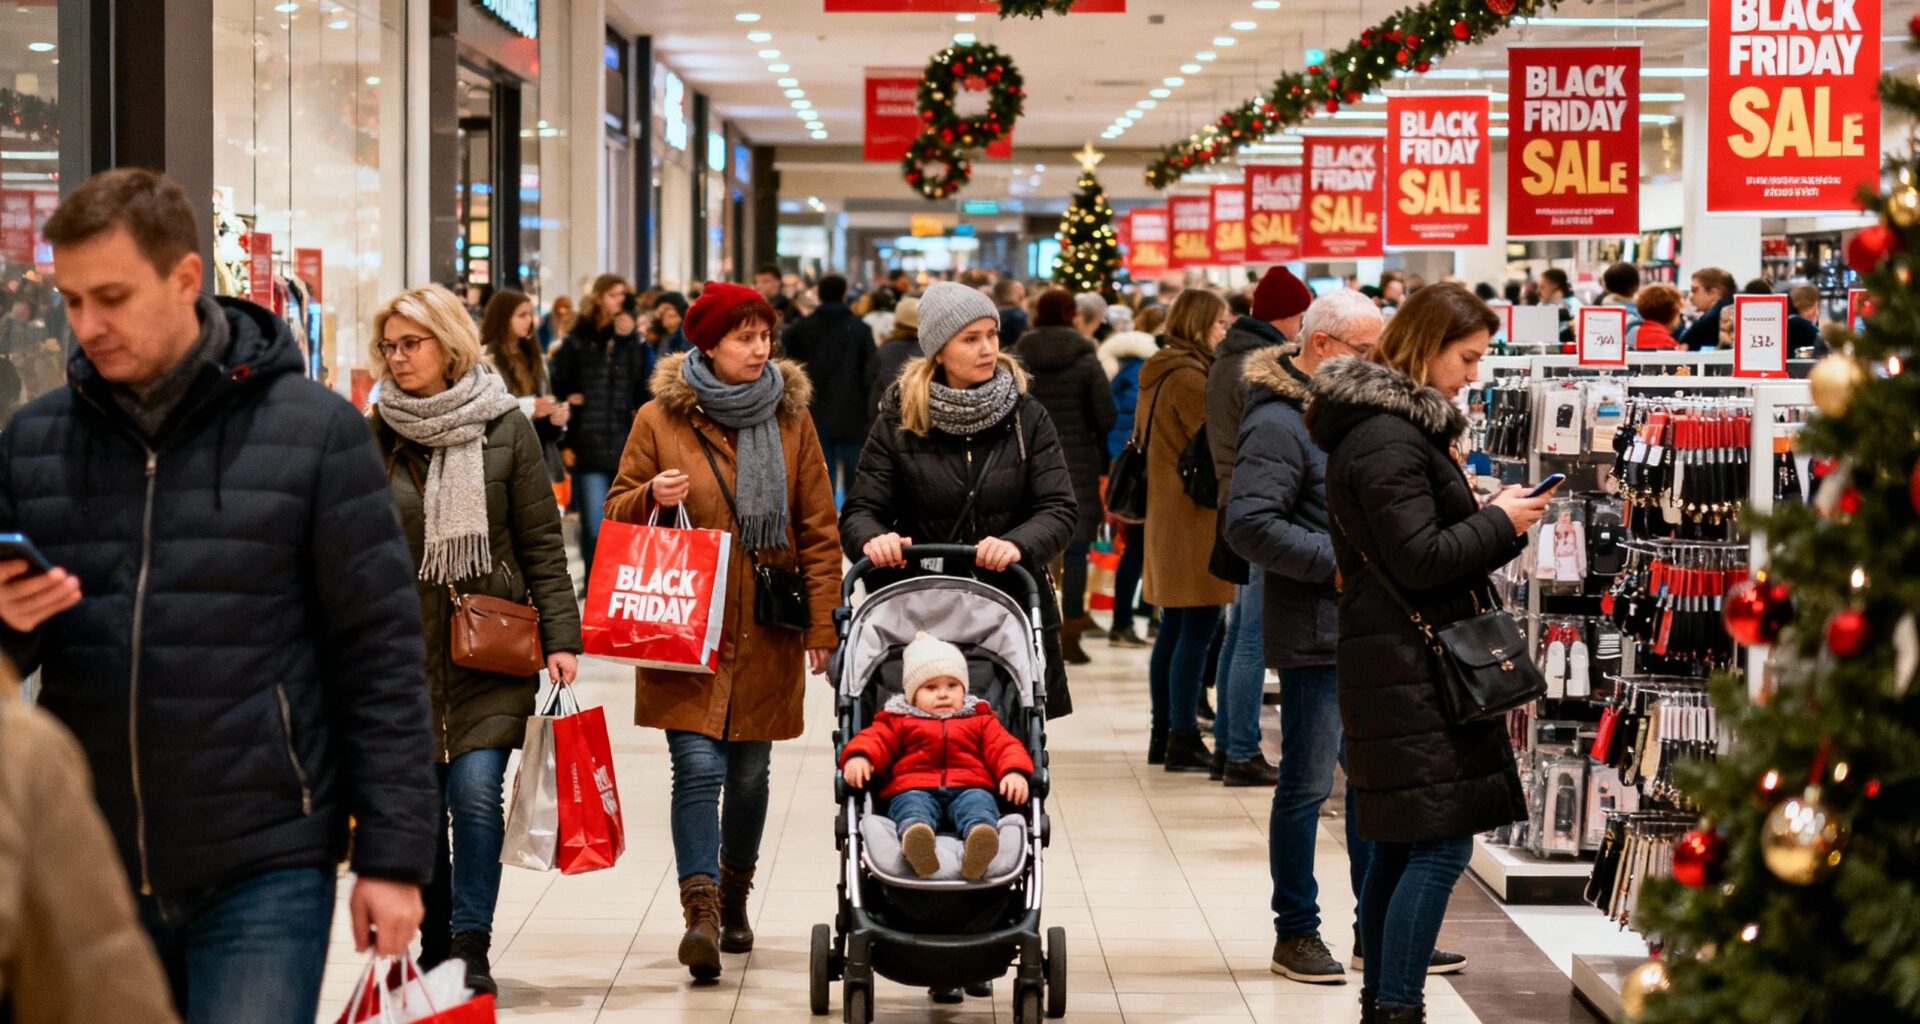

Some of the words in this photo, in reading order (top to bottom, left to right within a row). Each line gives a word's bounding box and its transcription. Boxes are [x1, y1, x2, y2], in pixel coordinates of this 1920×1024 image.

[1731, 0, 1862, 32] BLACK
[1729, 34, 1863, 76] FRIDAY
[1525, 65, 1627, 98] BLACK
[1400, 110, 1479, 137] BLACK
[1523, 100, 1628, 132] FRIDAY
[1250, 213, 1300, 245] SAL
[615, 564, 698, 597] BLACK
[607, 592, 697, 625] FRIDAY
